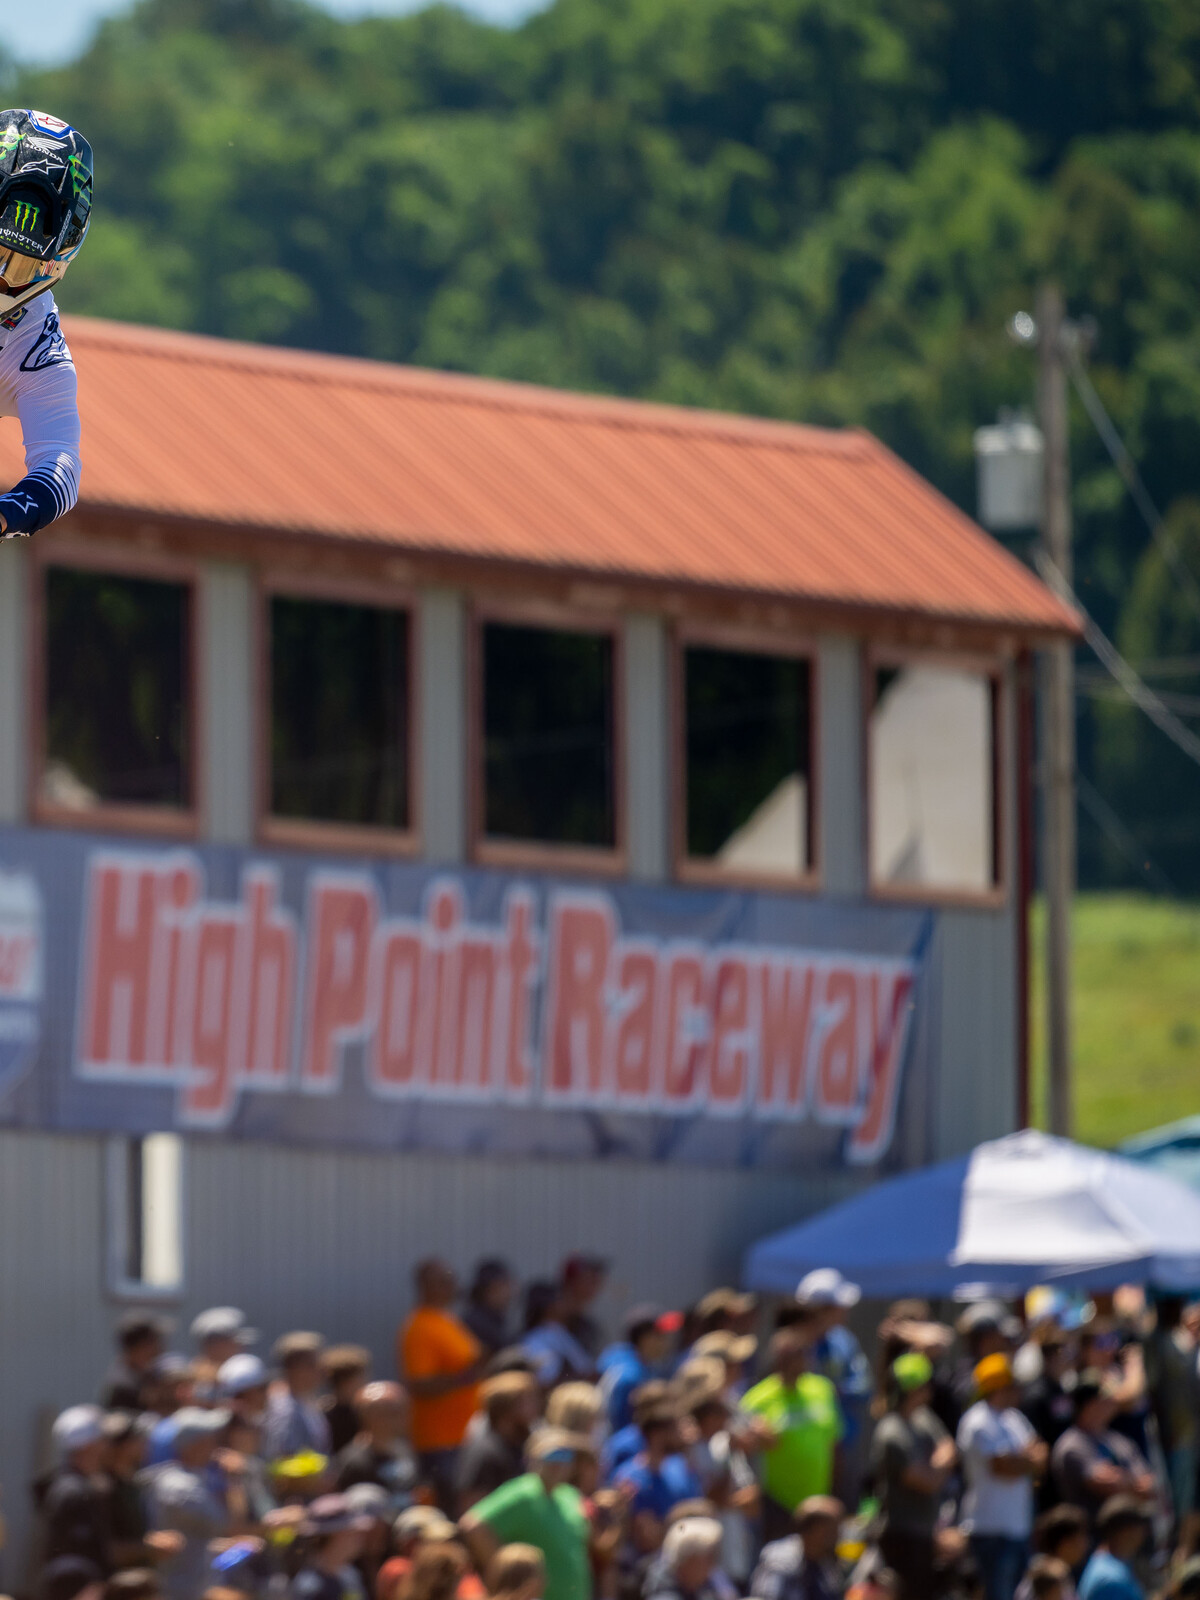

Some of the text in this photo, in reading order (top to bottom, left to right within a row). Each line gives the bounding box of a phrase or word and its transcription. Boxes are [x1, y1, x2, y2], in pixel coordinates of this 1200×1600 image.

[24, 143, 64, 164] HONDA
[75, 847, 914, 1164] High Point Raceway
